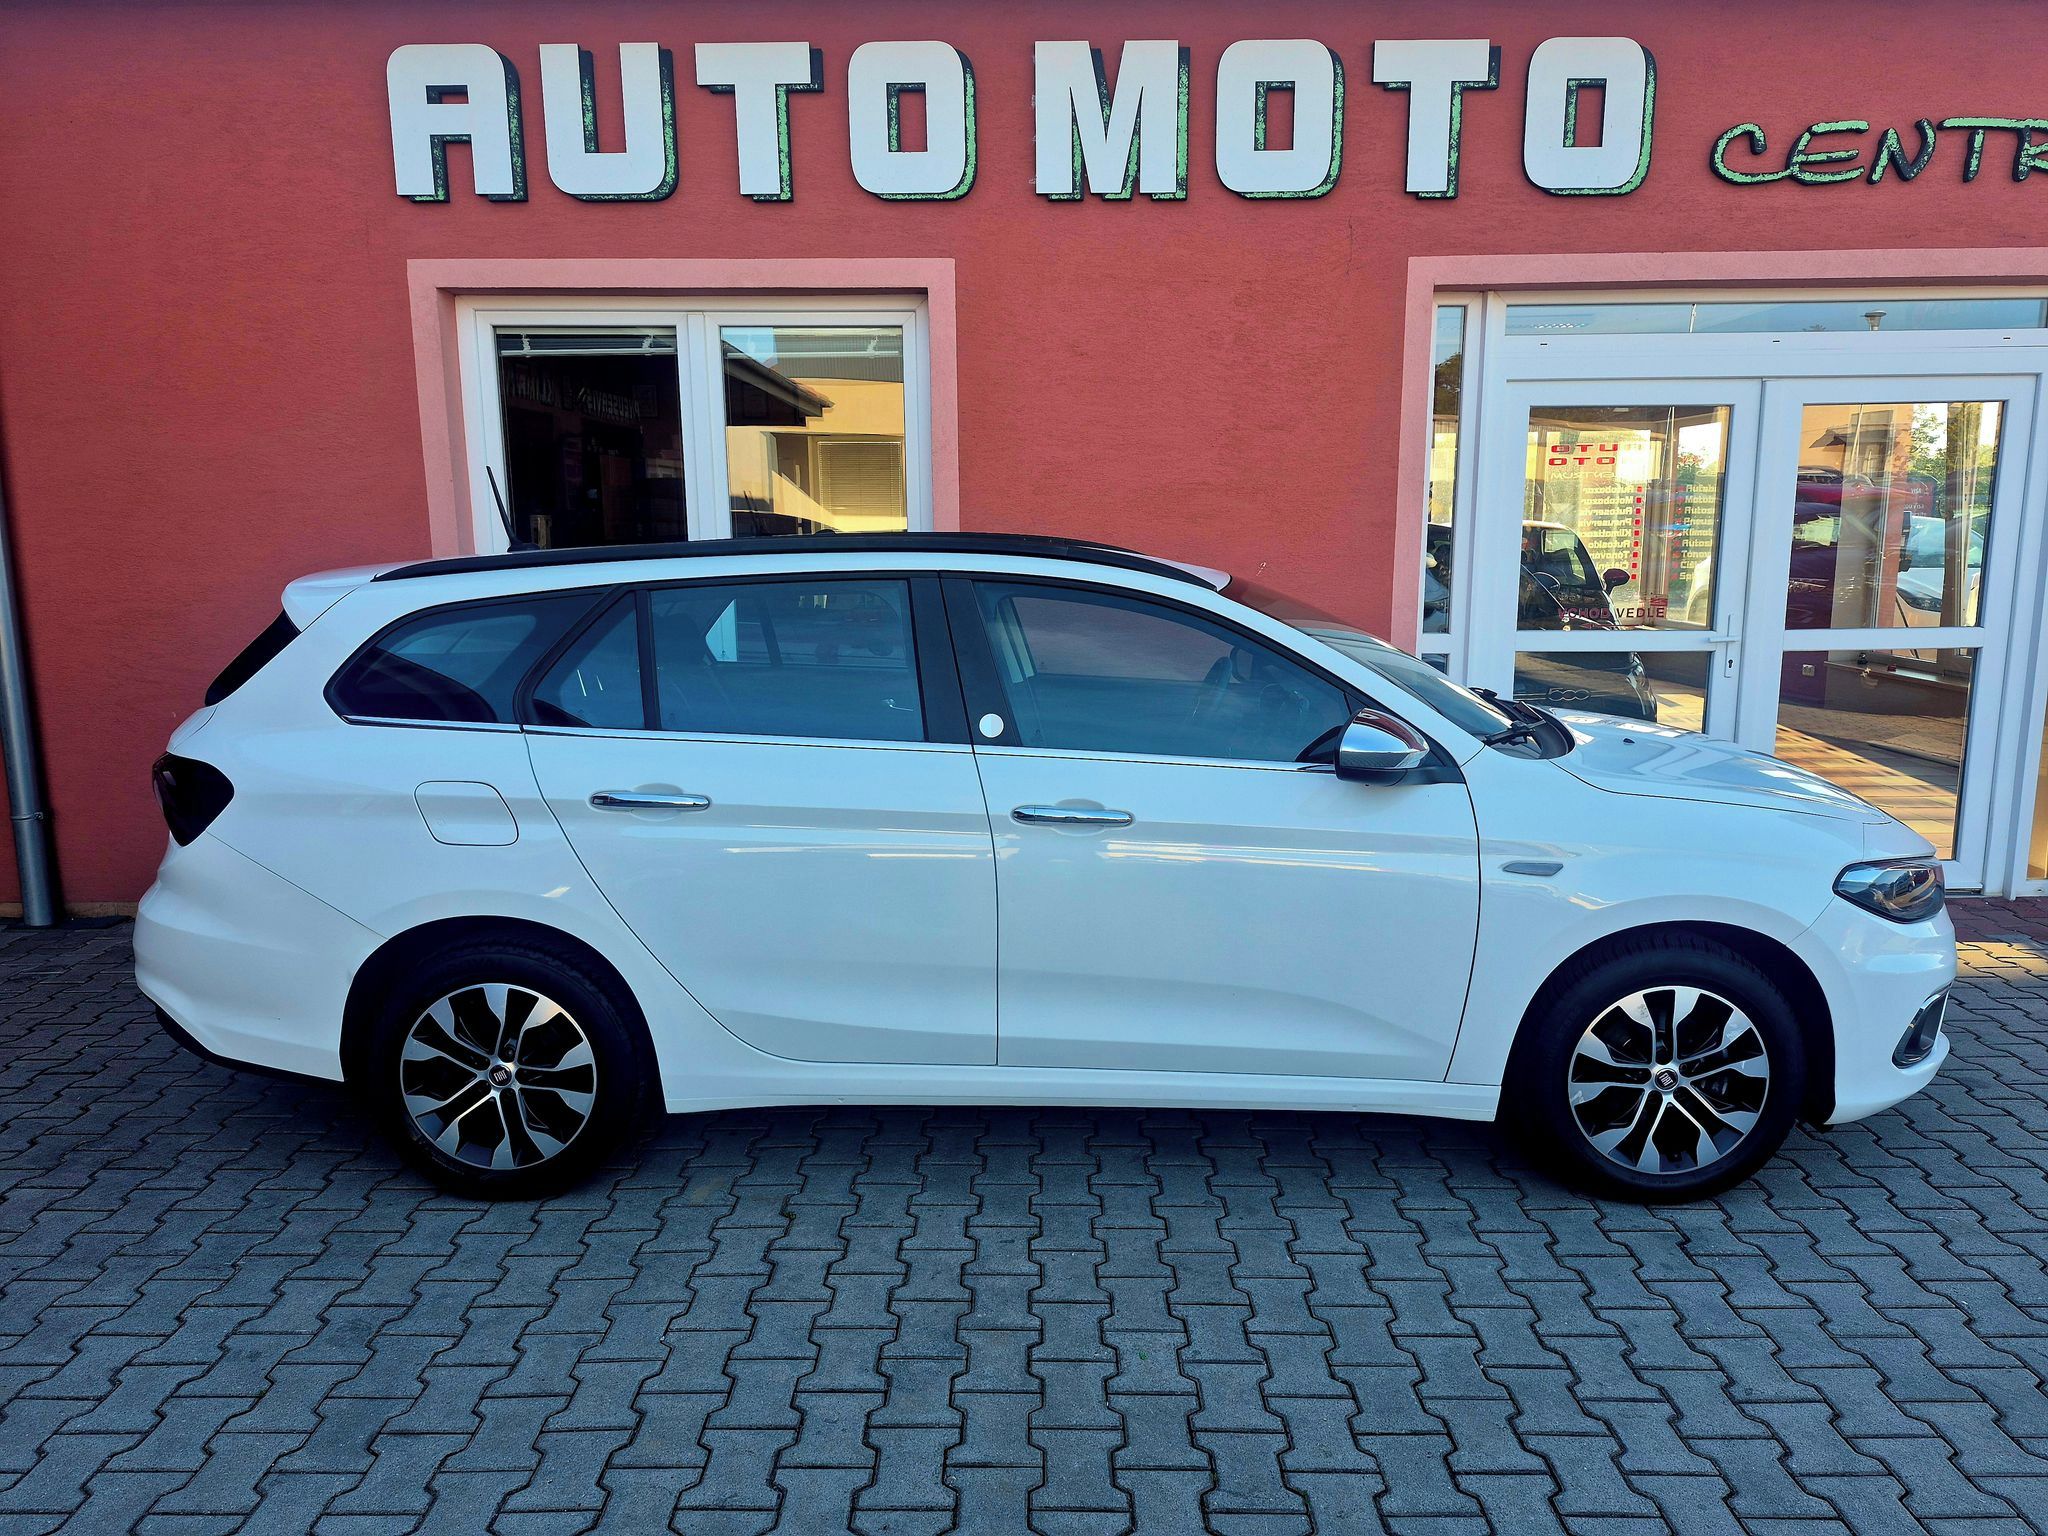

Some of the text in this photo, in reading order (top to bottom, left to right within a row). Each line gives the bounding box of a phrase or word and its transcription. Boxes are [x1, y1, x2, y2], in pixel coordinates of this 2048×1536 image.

[386, 41, 978, 204] AUTO
[1032, 36, 1657, 203] MOTO
[1557, 607, 1666, 620] VCHOD VEDLE
